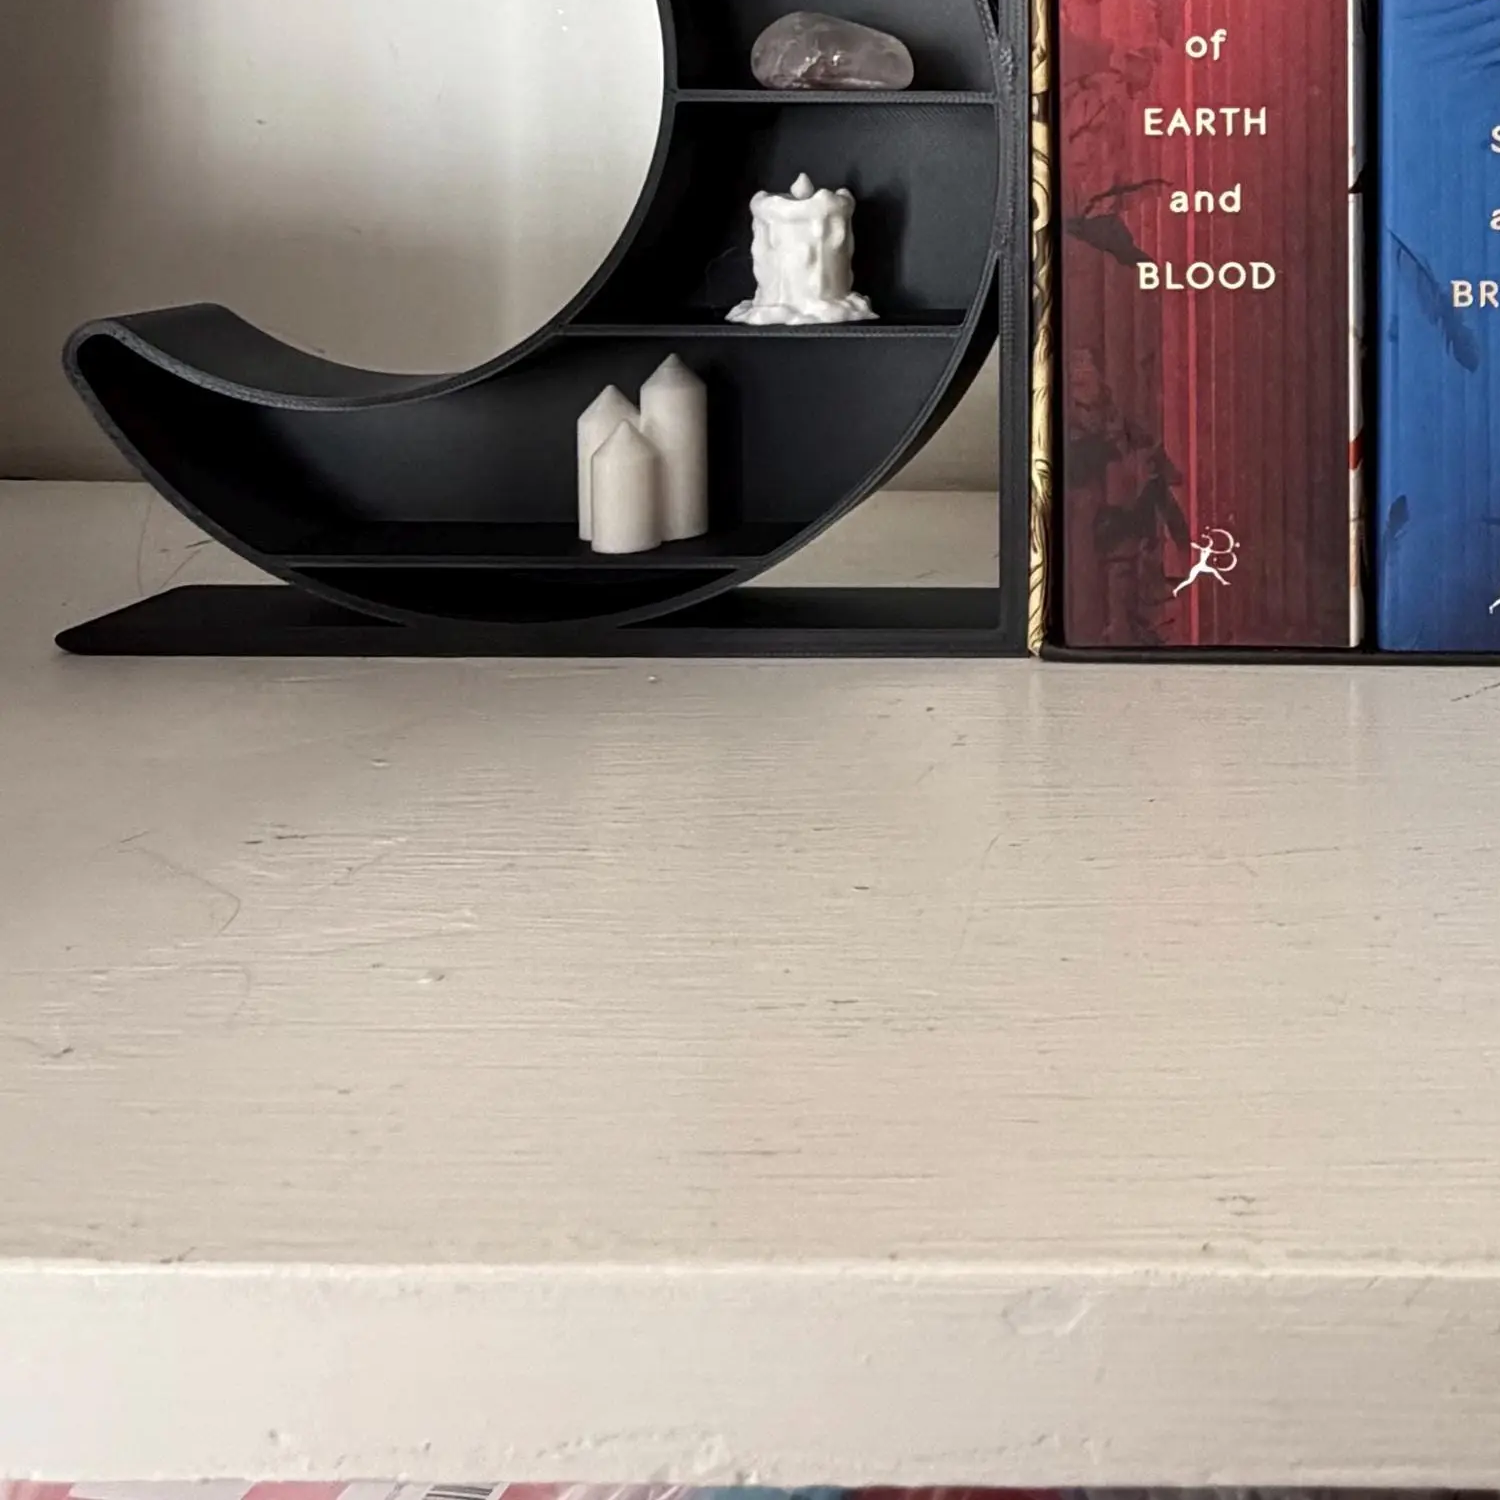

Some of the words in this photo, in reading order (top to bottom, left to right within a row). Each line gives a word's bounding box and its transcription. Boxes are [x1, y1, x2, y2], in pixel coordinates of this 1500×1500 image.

[1184, 28, 1227, 60] of
[1143, 106, 1267, 137] EARTH
[1169, 183, 1242, 213] and
[1136, 261, 1276, 290] BLOOD
